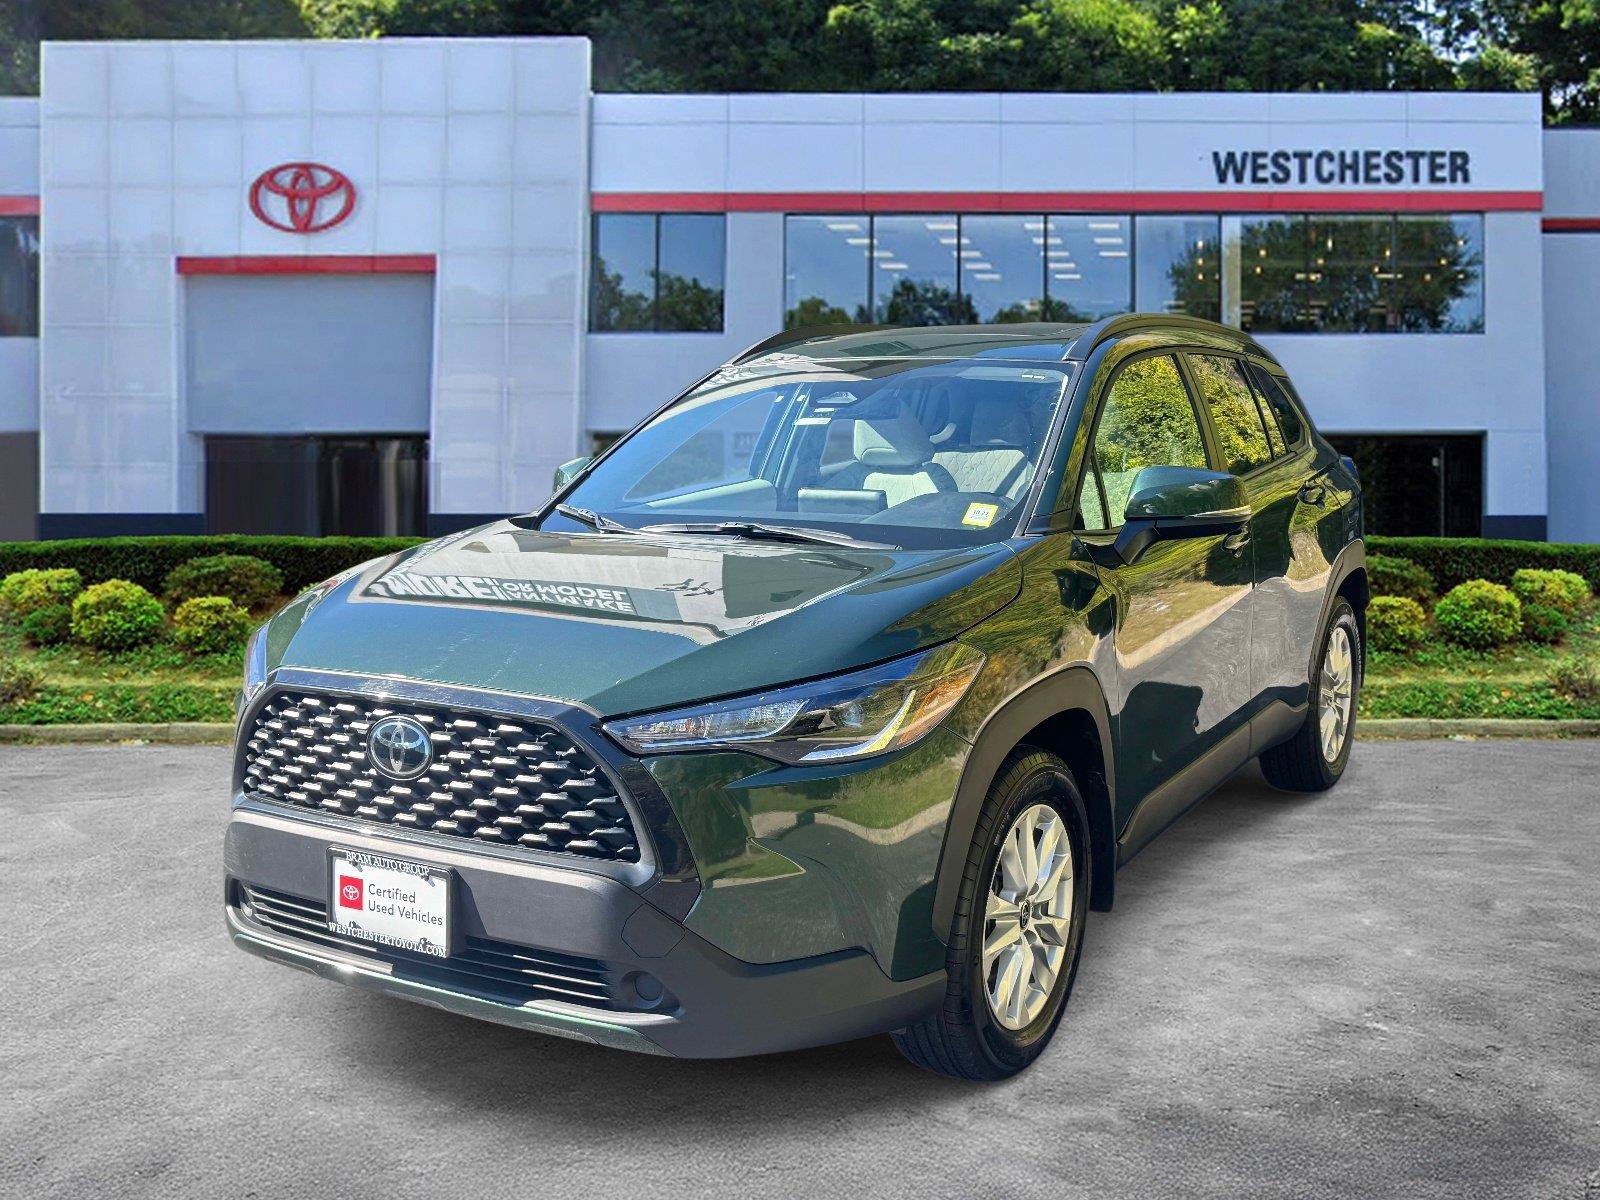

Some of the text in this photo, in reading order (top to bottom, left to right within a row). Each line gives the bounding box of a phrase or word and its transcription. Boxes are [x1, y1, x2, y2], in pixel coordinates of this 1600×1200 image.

[1212, 150, 1471, 184] WESTCHESTER
[373, 857, 398, 869] AUTO
[397, 861, 430, 876] GROUP
[368, 883, 416, 904] Certified
[368, 900, 443, 926] Used Vehicles
